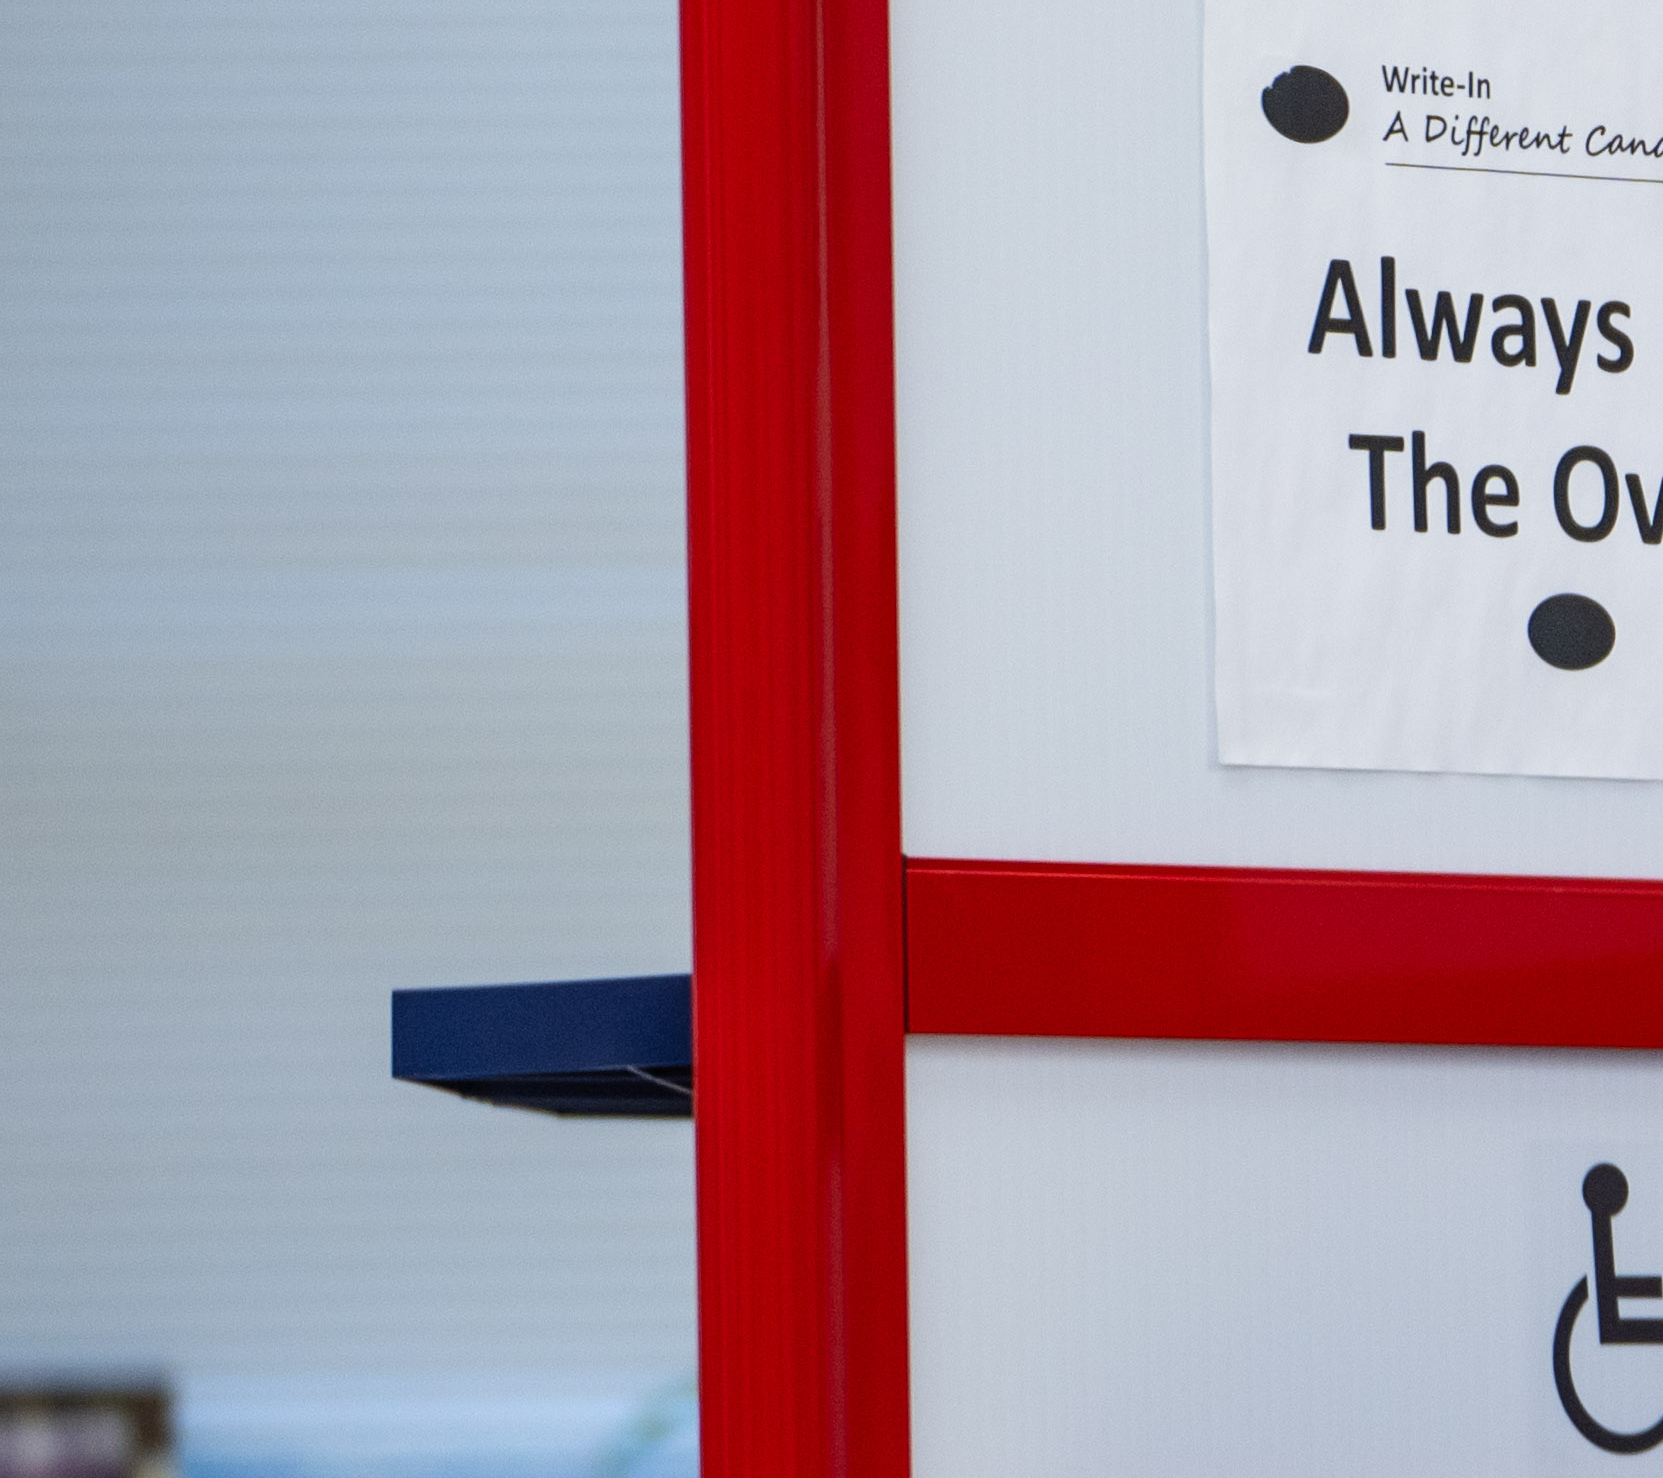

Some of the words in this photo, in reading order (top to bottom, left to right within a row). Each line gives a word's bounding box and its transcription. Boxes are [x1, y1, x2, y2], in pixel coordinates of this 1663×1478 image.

[1381, 64, 1491, 100] Write-In
[1382, 110, 1409, 143] A
[1424, 114, 1574, 157] Different
[1307, 255, 1635, 396] Always
[1347, 429, 1520, 539] The
